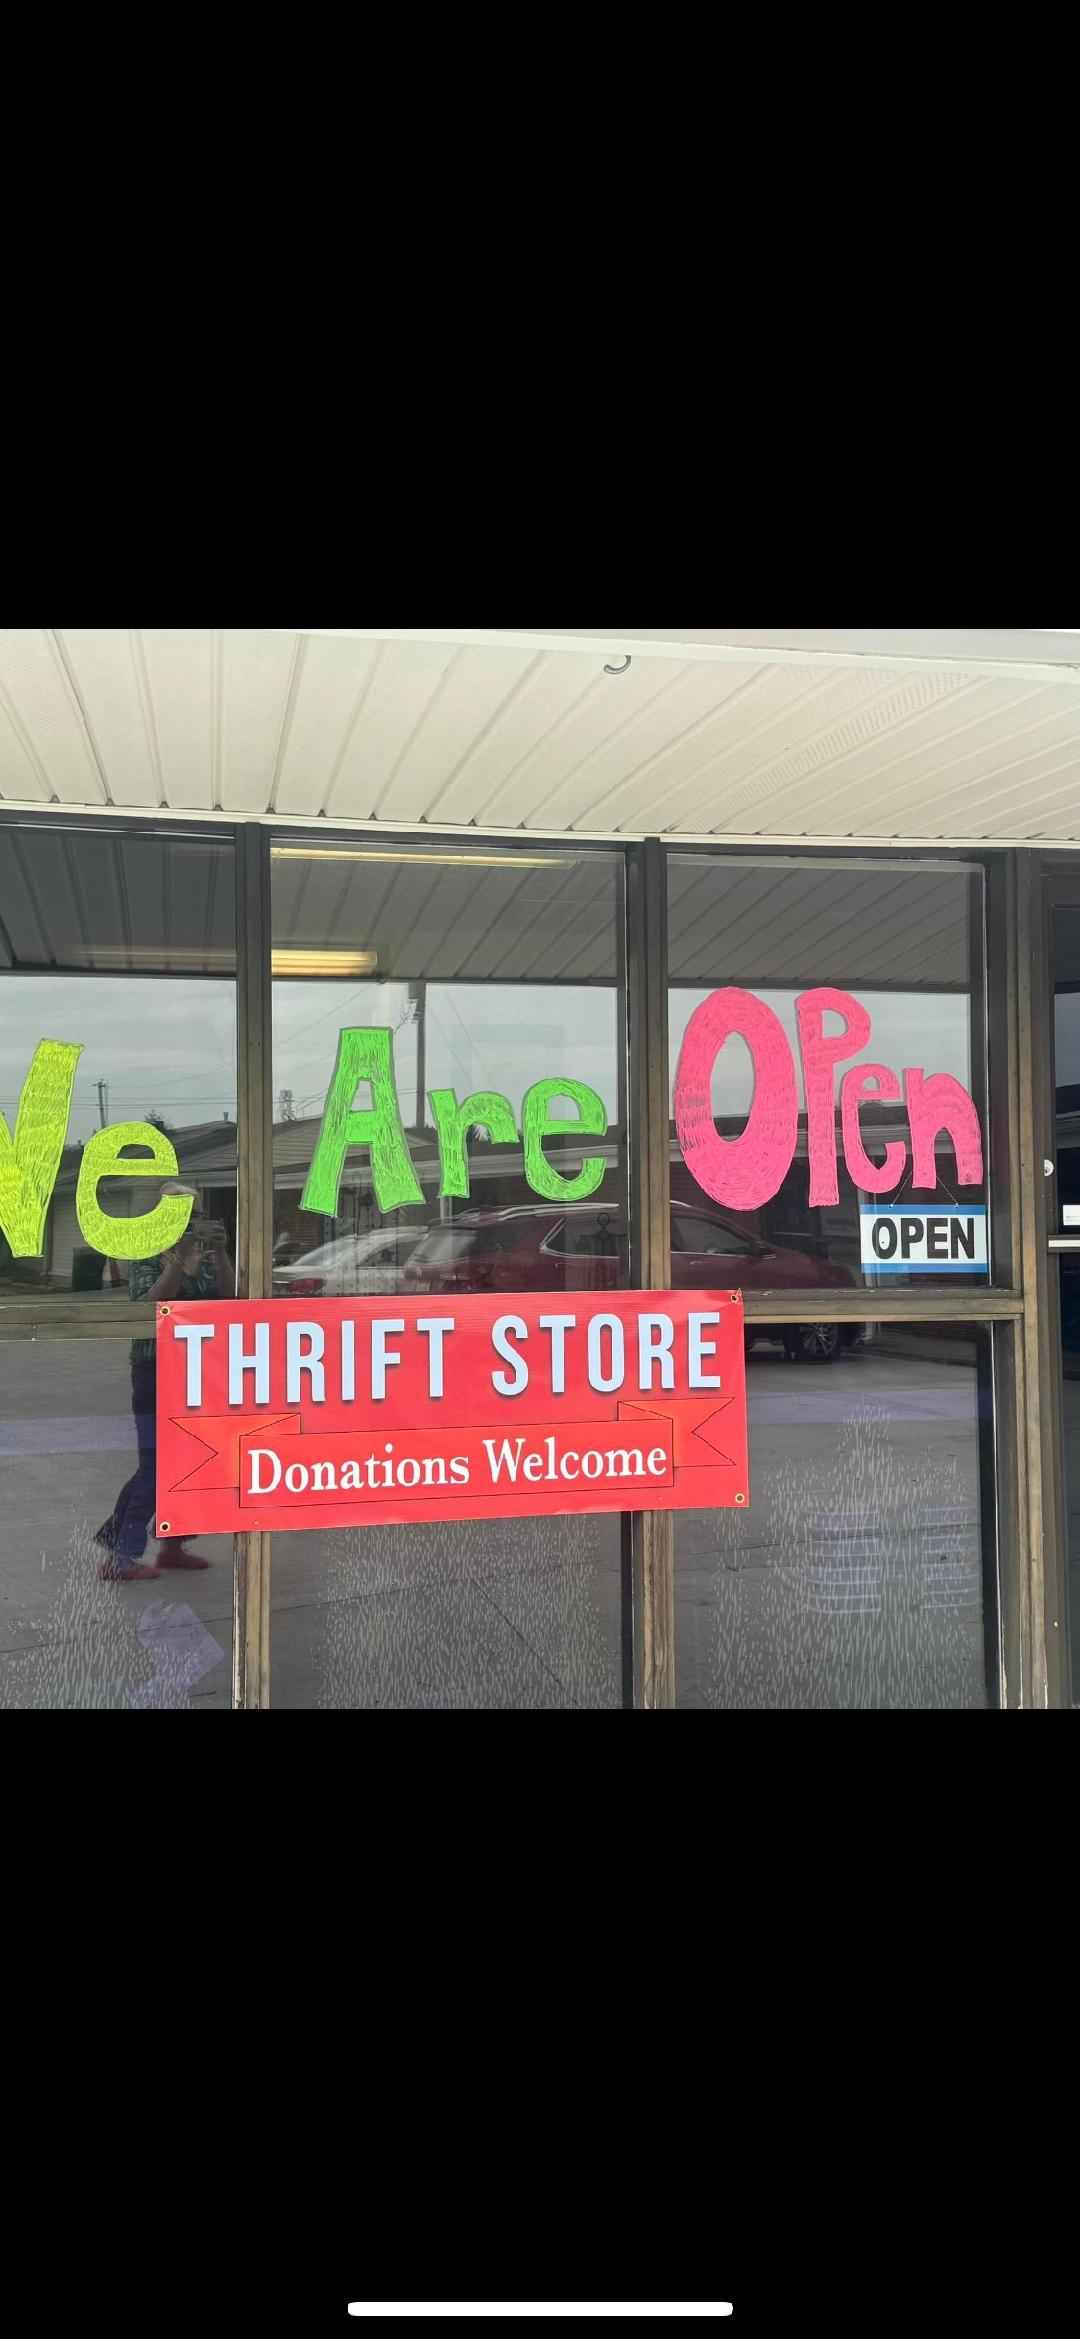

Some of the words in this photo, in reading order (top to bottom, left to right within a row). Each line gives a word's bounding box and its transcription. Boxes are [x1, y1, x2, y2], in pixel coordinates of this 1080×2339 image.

[300, 1025, 608, 1218] Are
[871, 1217, 976, 1260] OPEN
[173, 1317, 456, 1408] THRIFT
[490, 1311, 722, 1397] STORE
[247, 1444, 469, 1494] Donations
[483, 1438, 667, 1483] Welcome
